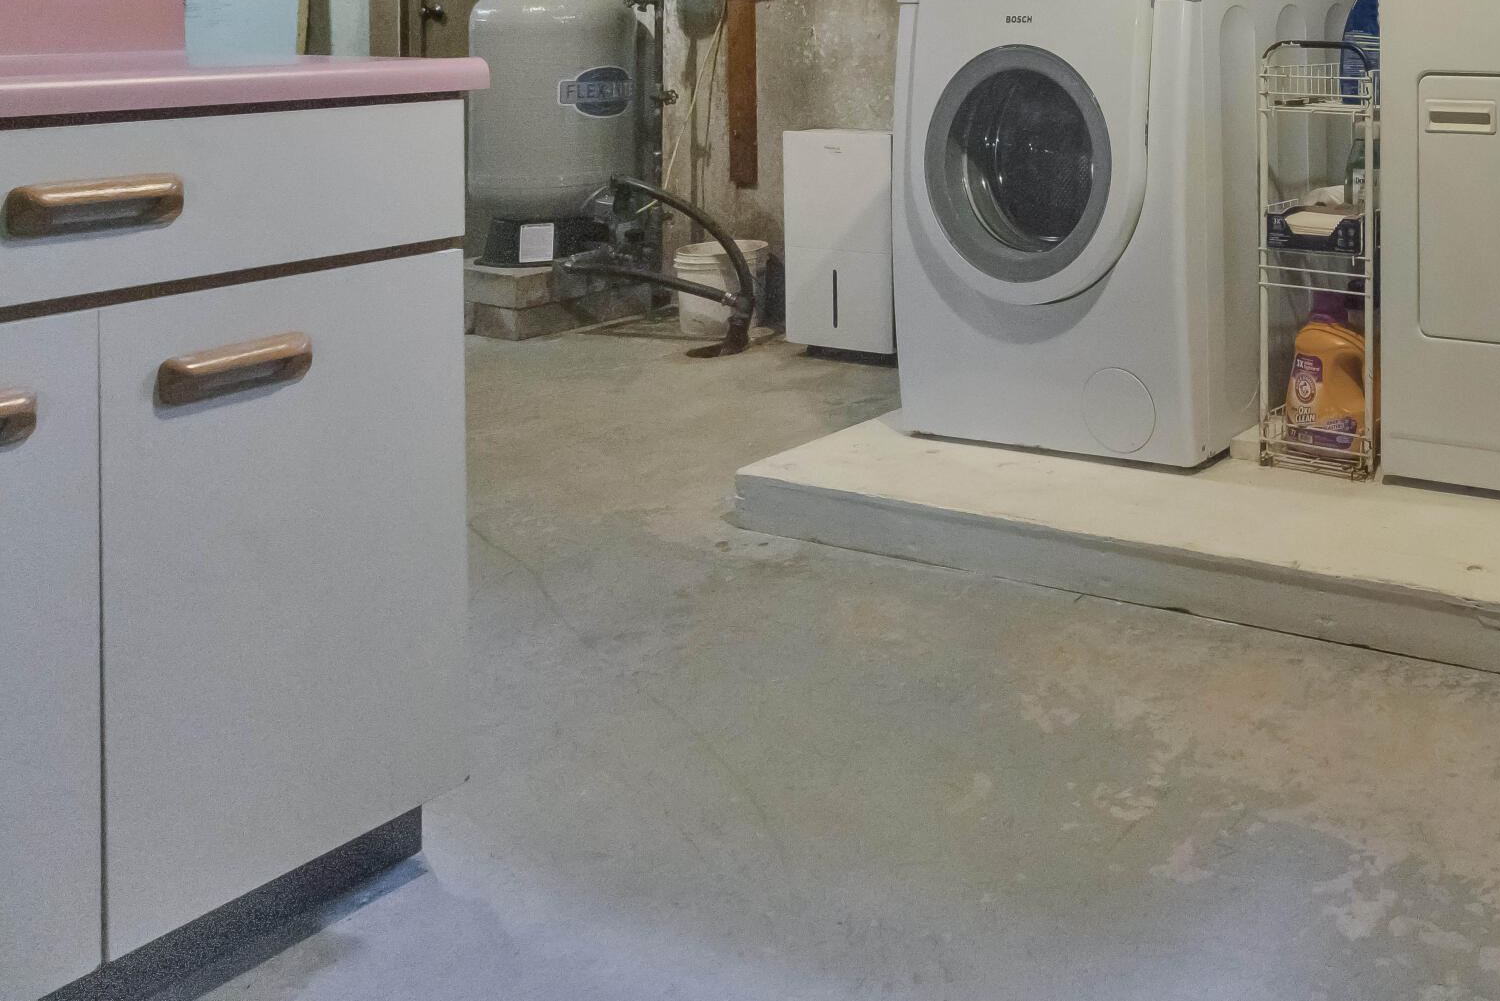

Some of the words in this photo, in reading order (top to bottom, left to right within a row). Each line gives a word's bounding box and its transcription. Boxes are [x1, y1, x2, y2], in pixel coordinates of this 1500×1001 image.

[1005, 15, 1033, 24] BOSCH
[1298, 406, 1311, 415] OXI
[1295, 413, 1316, 423] CLEAN
